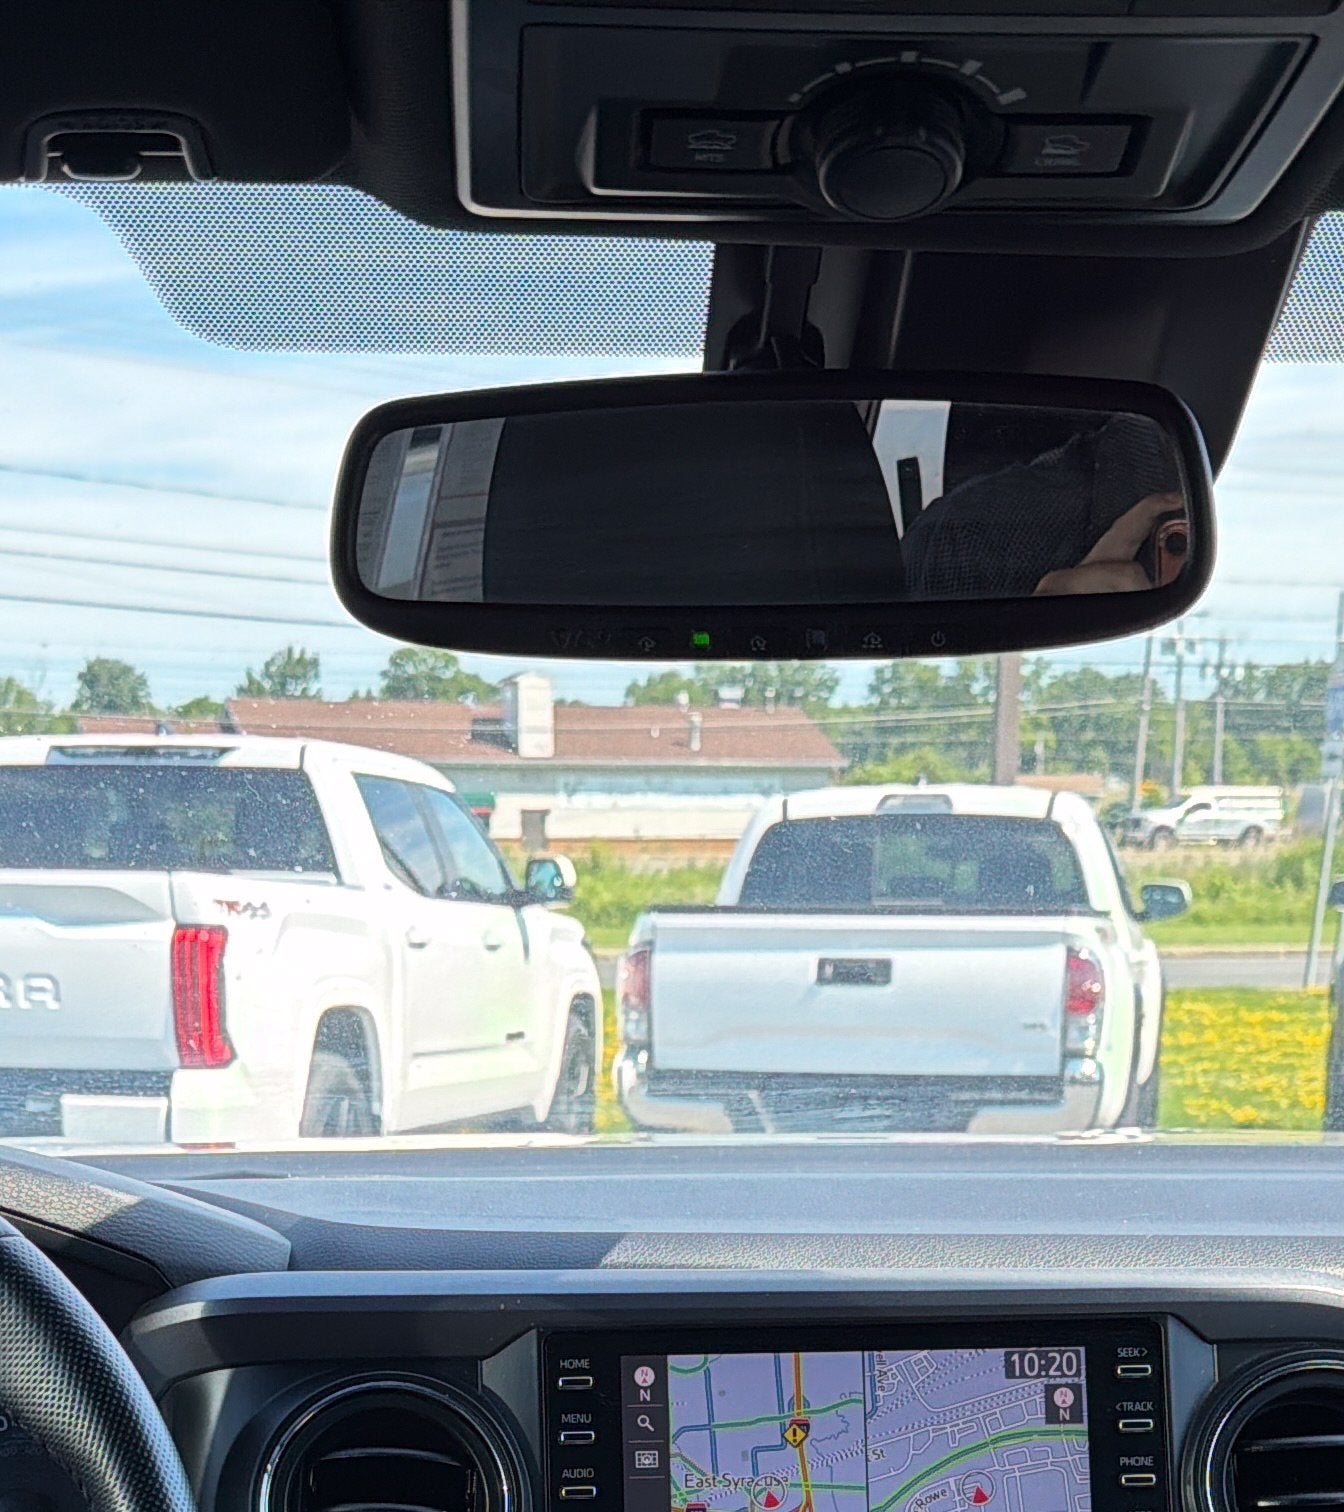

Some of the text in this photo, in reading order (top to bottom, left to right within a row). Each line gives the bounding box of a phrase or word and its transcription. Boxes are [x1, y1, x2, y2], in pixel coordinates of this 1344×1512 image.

[559, 1358, 591, 1369] HOME
[1010, 1352, 1078, 1378] 10:20
[875, 1370, 887, 1393] Ave
[639, 1388, 651, 1402] N
[561, 1413, 592, 1424] MENU
[1059, 1407, 1070, 1421] N
[1119, 1456, 1154, 1467] PHONE
[562, 1467, 594, 1479] AUDIO
[685, 1472, 789, 1490] East Syracuse
[916, 1486, 948, 1508] Rowe
